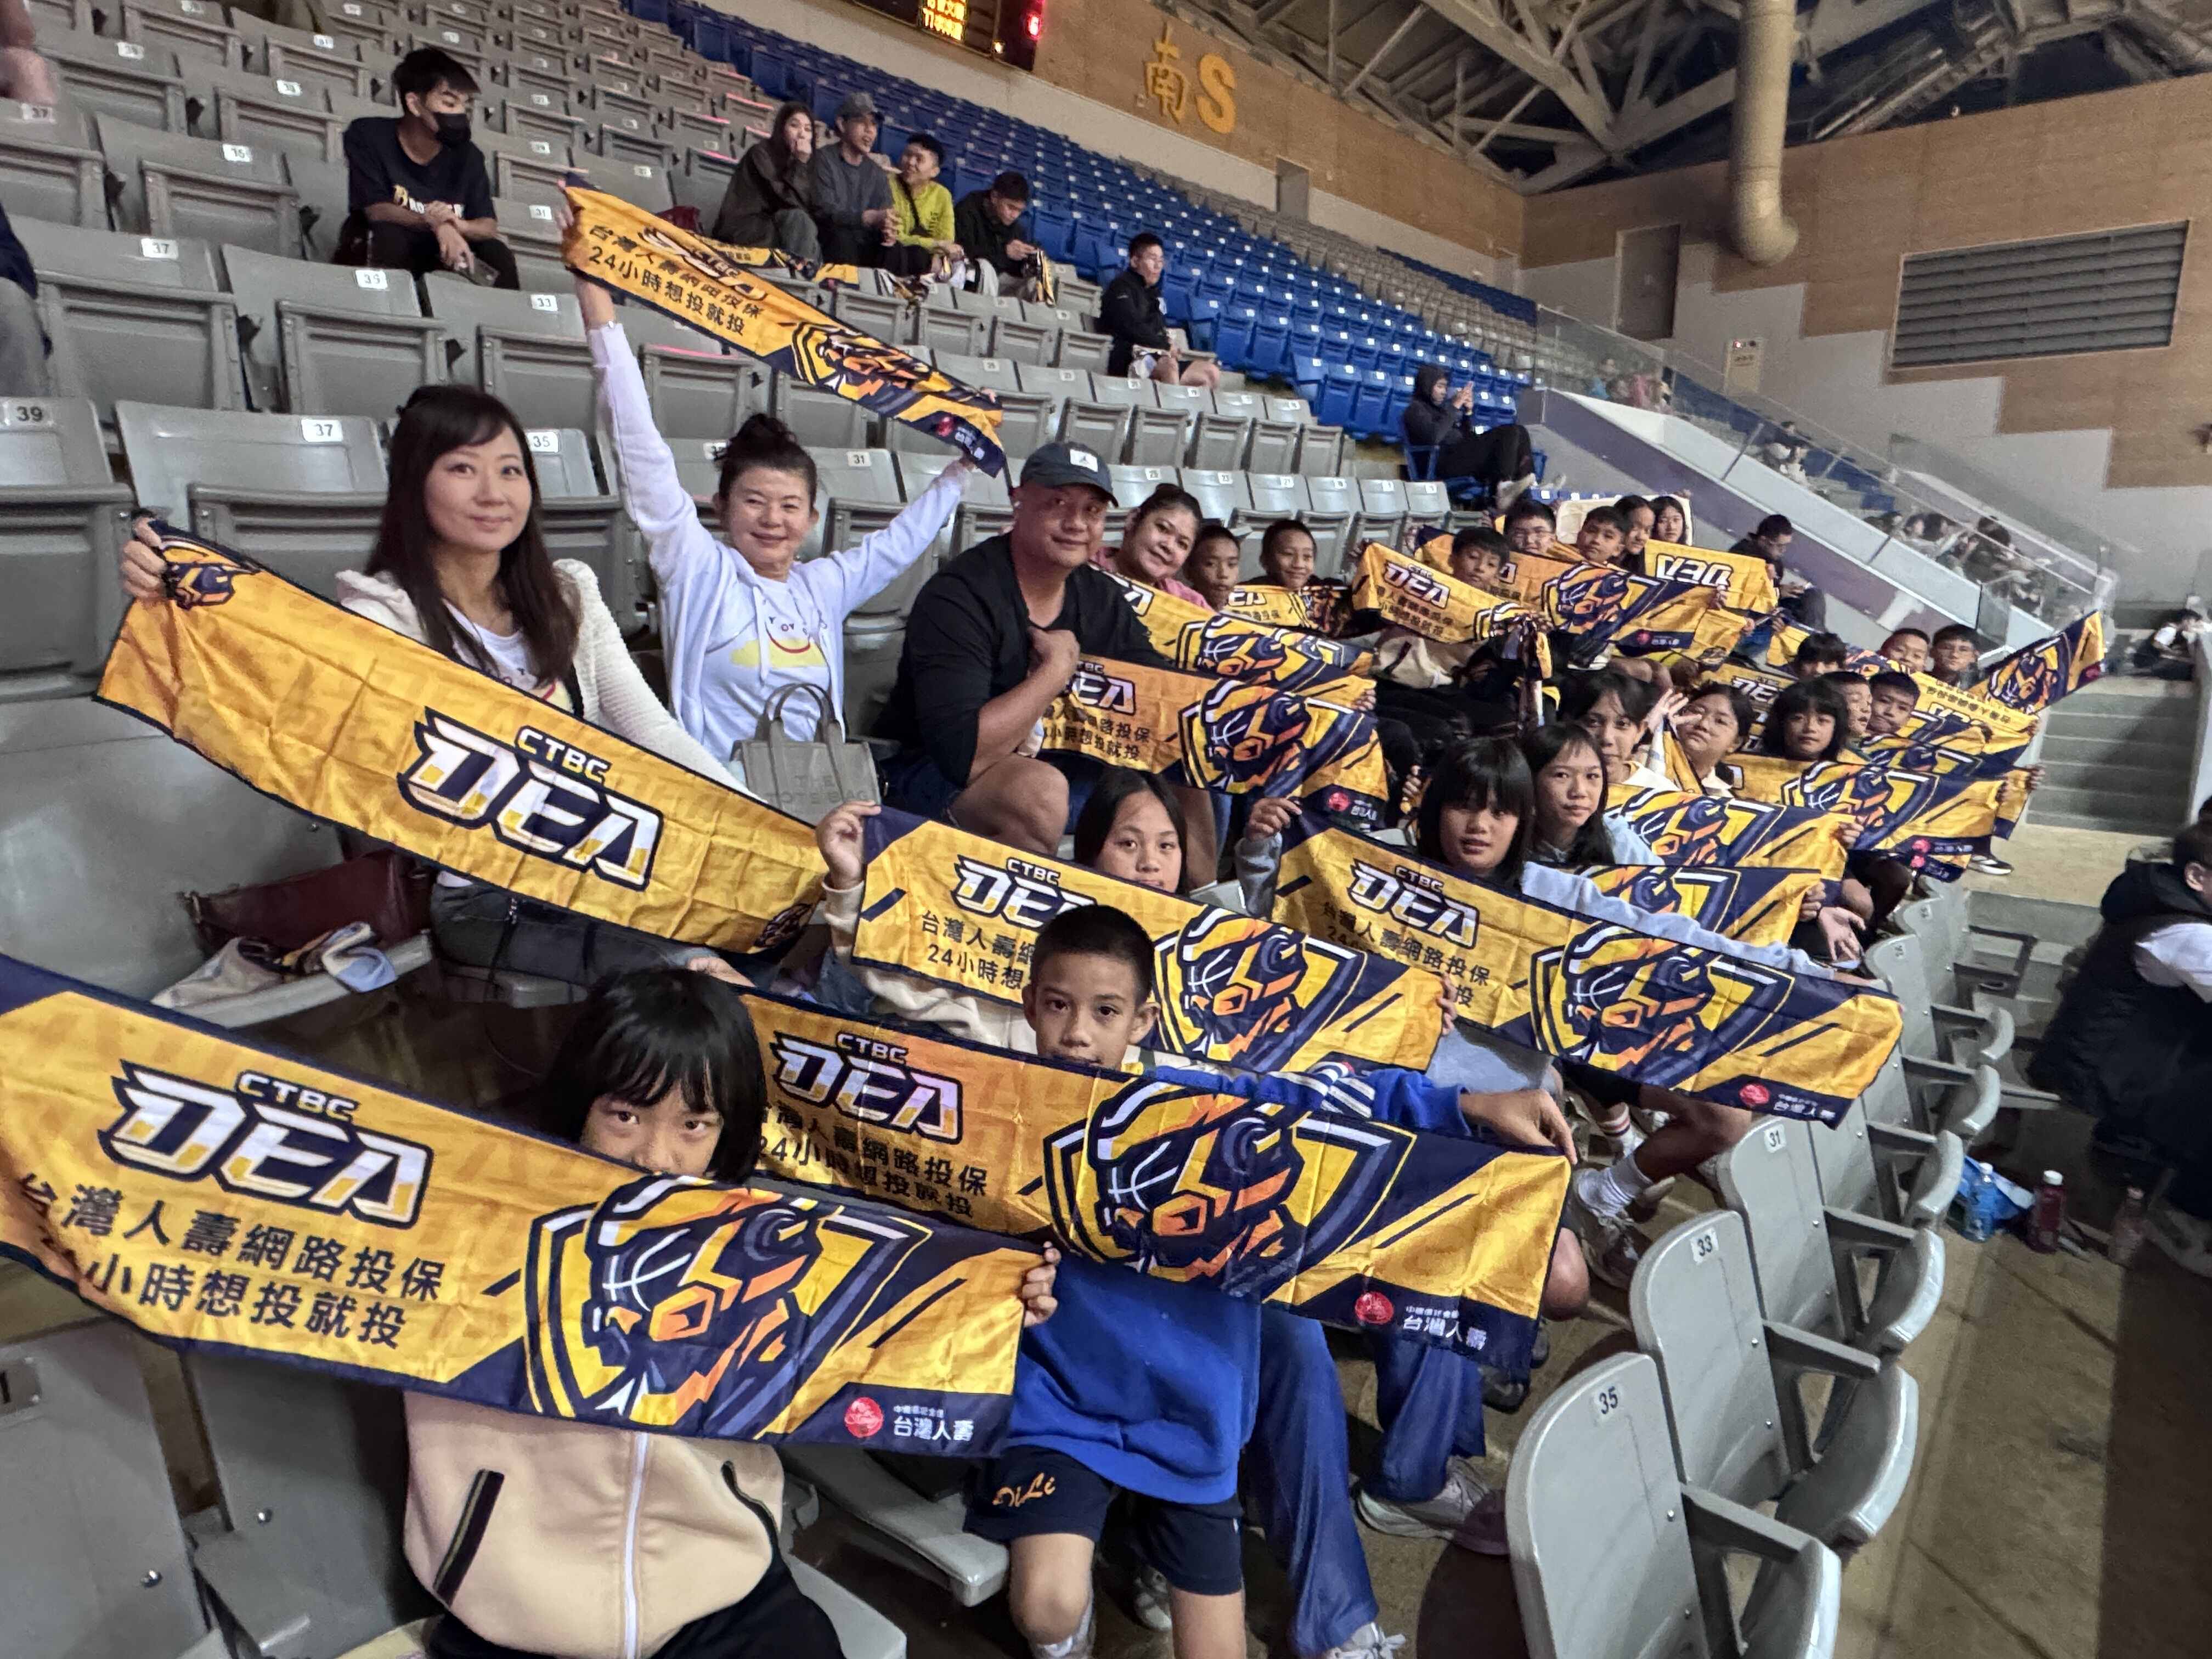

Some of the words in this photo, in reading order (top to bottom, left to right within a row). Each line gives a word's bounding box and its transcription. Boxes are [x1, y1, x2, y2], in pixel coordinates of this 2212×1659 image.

[1144, 20, 1192, 125] 南
[1196, 54, 1237, 134] S
[151, 242, 169, 254] 37
[536, 297, 551, 308] 33
[16, 406, 43, 422] 39
[315, 424, 334, 437] 37
[533, 435, 550, 448] 35
[853, 454, 865, 465] 31
[1384, 561, 1450, 608] DEA
[1070, 671, 1135, 715] EA
[518, 727, 608, 782] CTBC
[402, 710, 662, 889] DEA
[1007, 857, 1060, 885] CTBC
[1396, 867, 1444, 893] CTBC
[1348, 860, 1479, 948] DEA
[837, 1032, 908, 1064] CTBC
[238, 1073, 358, 1121] CTBC
[772, 1033, 962, 1143] DEA
[100, 1061, 433, 1228] DEA
[1769, 1130, 1781, 1147] 31
[1697, 1235, 1712, 1256] 33
[61, 1246, 407, 1349] 小時想投就投
[1599, 1386, 1618, 1415] 35
[894, 1415, 975, 1442] 台灣人壽
